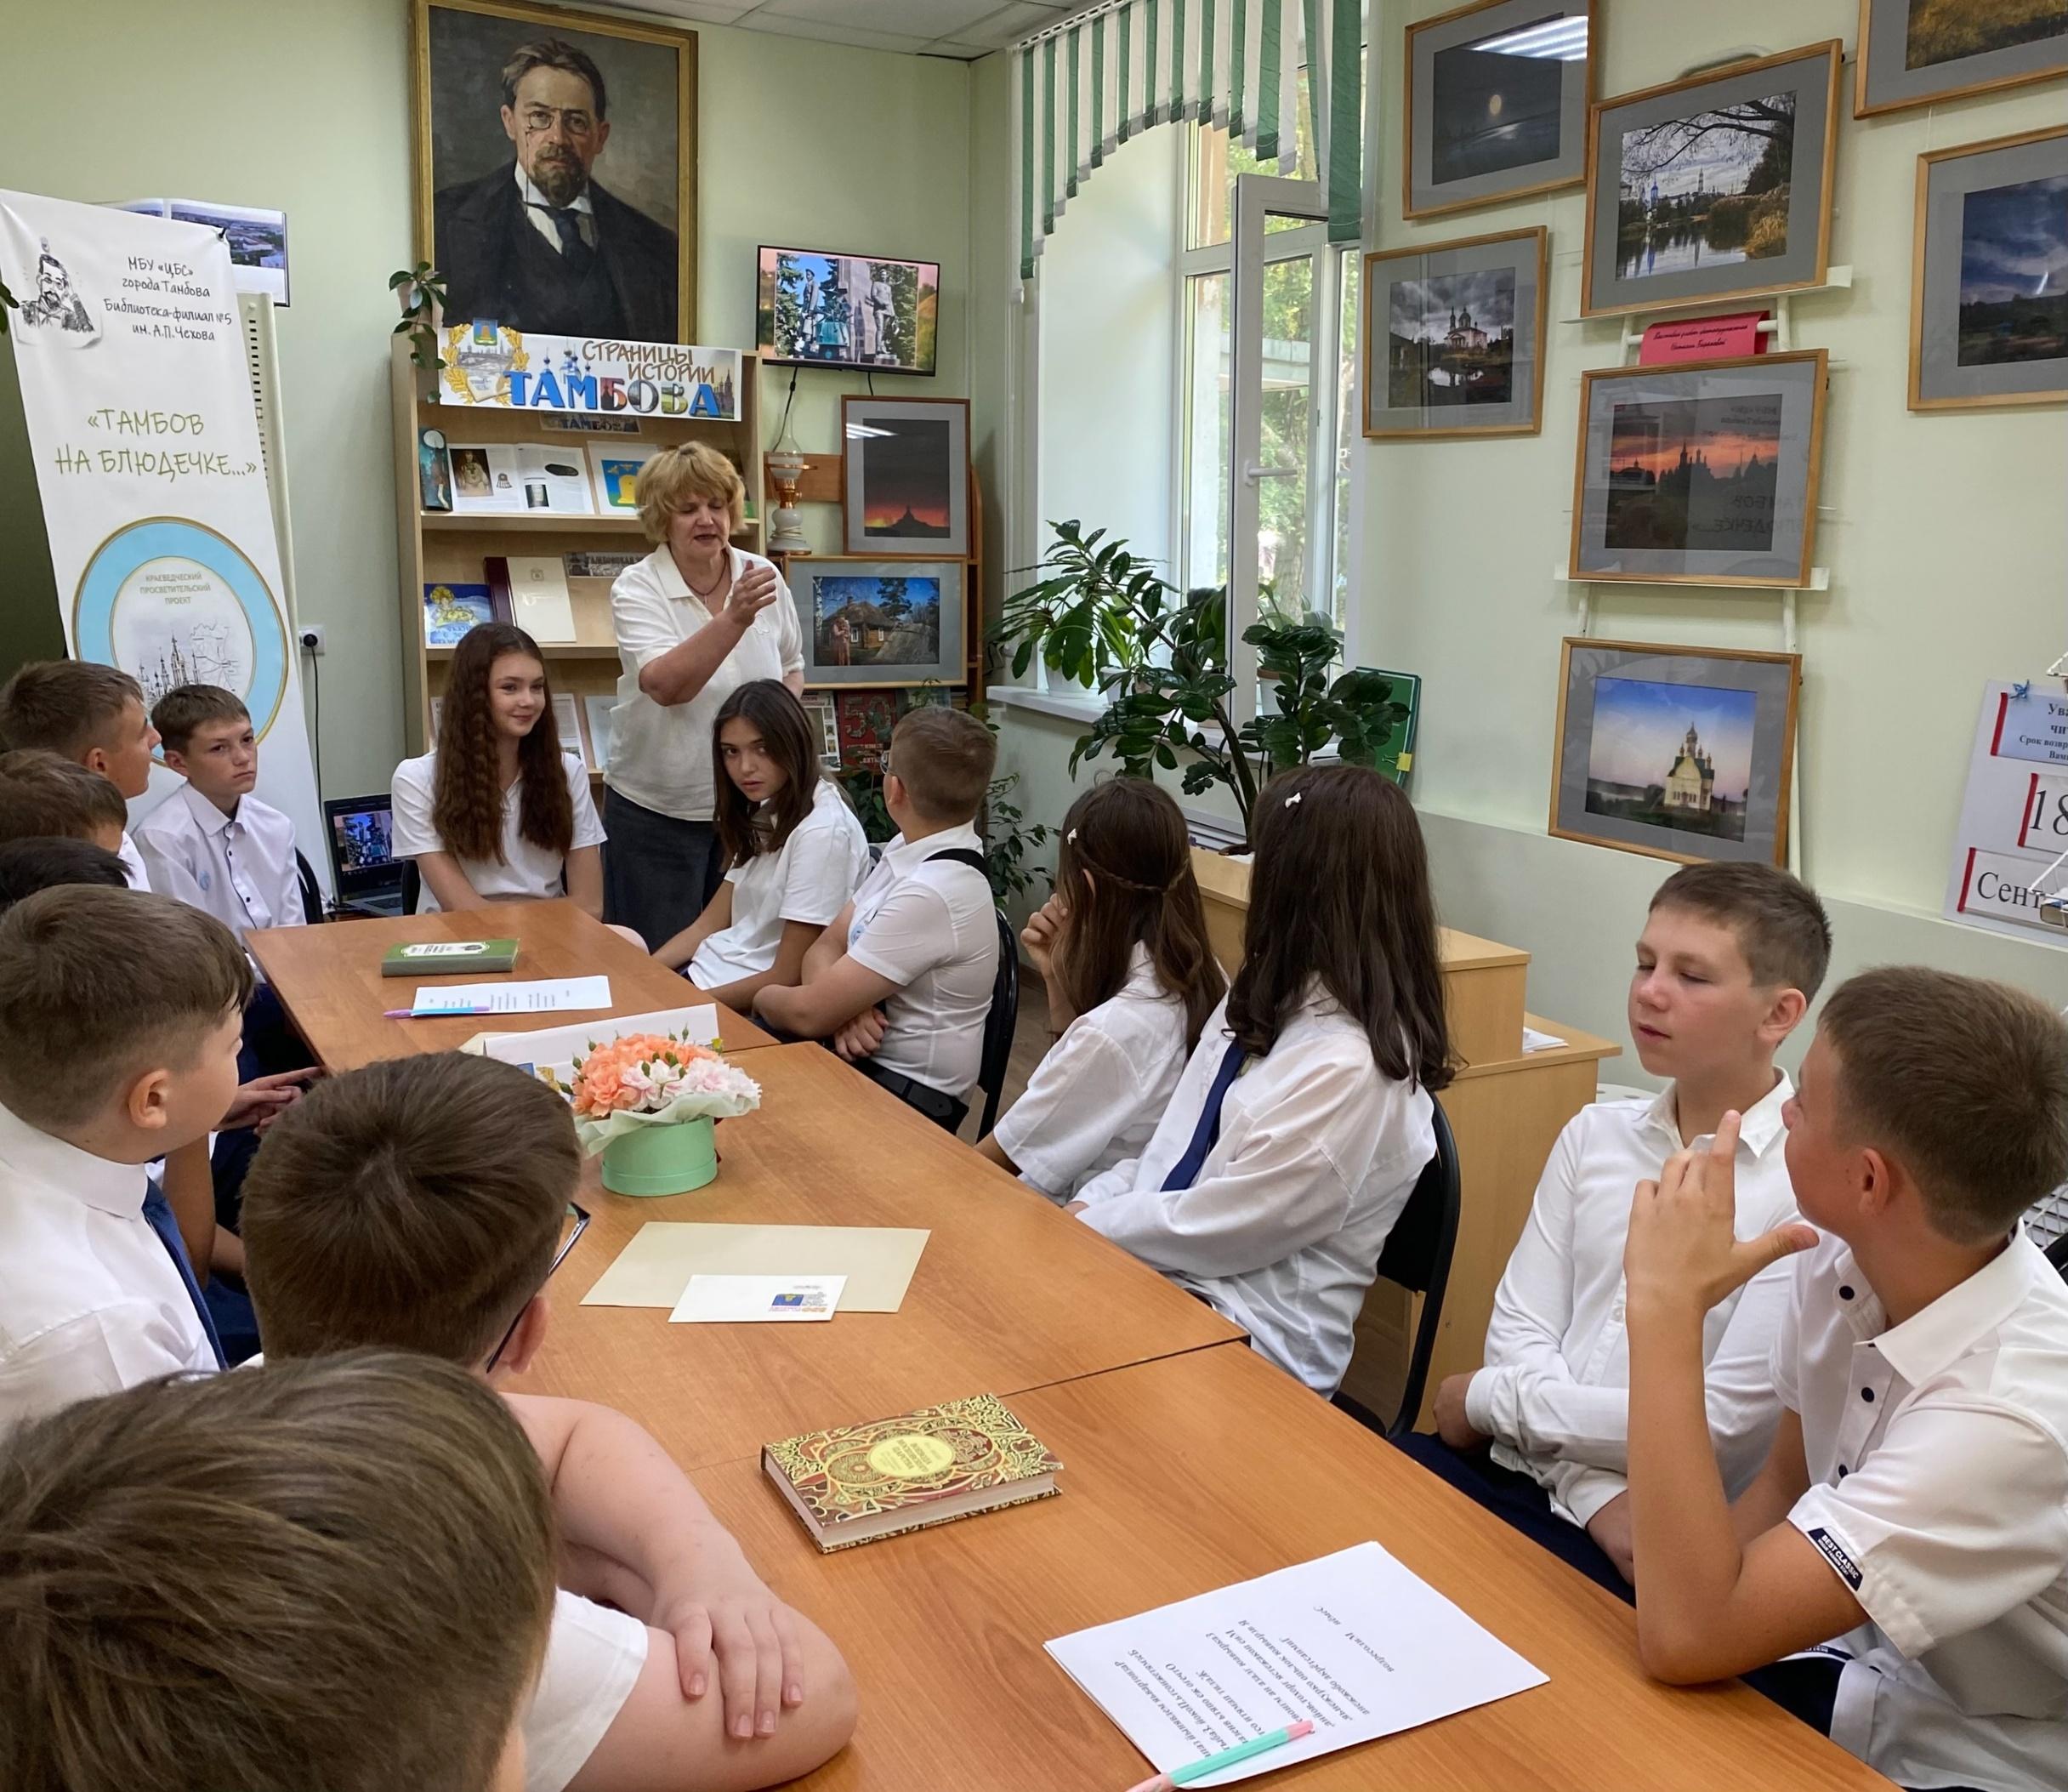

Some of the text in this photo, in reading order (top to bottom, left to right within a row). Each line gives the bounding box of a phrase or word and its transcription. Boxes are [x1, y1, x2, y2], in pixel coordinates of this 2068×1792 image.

[128, 256, 193, 279] МБУ «ЦБС»
[122, 277, 210, 297] города Тамбова
[104, 298, 214, 322] Библиотека-филиал
[582, 339, 695, 365] СТРАНИЦЫ
[628, 363, 716, 384] ИСТОРИИ
[503, 370, 721, 418] ТАМБОВА
[88, 409, 204, 436] «ТАМБОВ
[55, 444, 258, 482] НА БЛЮДЕЧКЕ...»
[164, 596, 191, 605] ПРОЕКТ
[2020, 735, 2042, 746] Срок
[2051, 725, 2068, 734] чи
[1977, 872, 2042, 910] Сент
[1821, 1534, 1859, 1579] BEST CLASSIC
